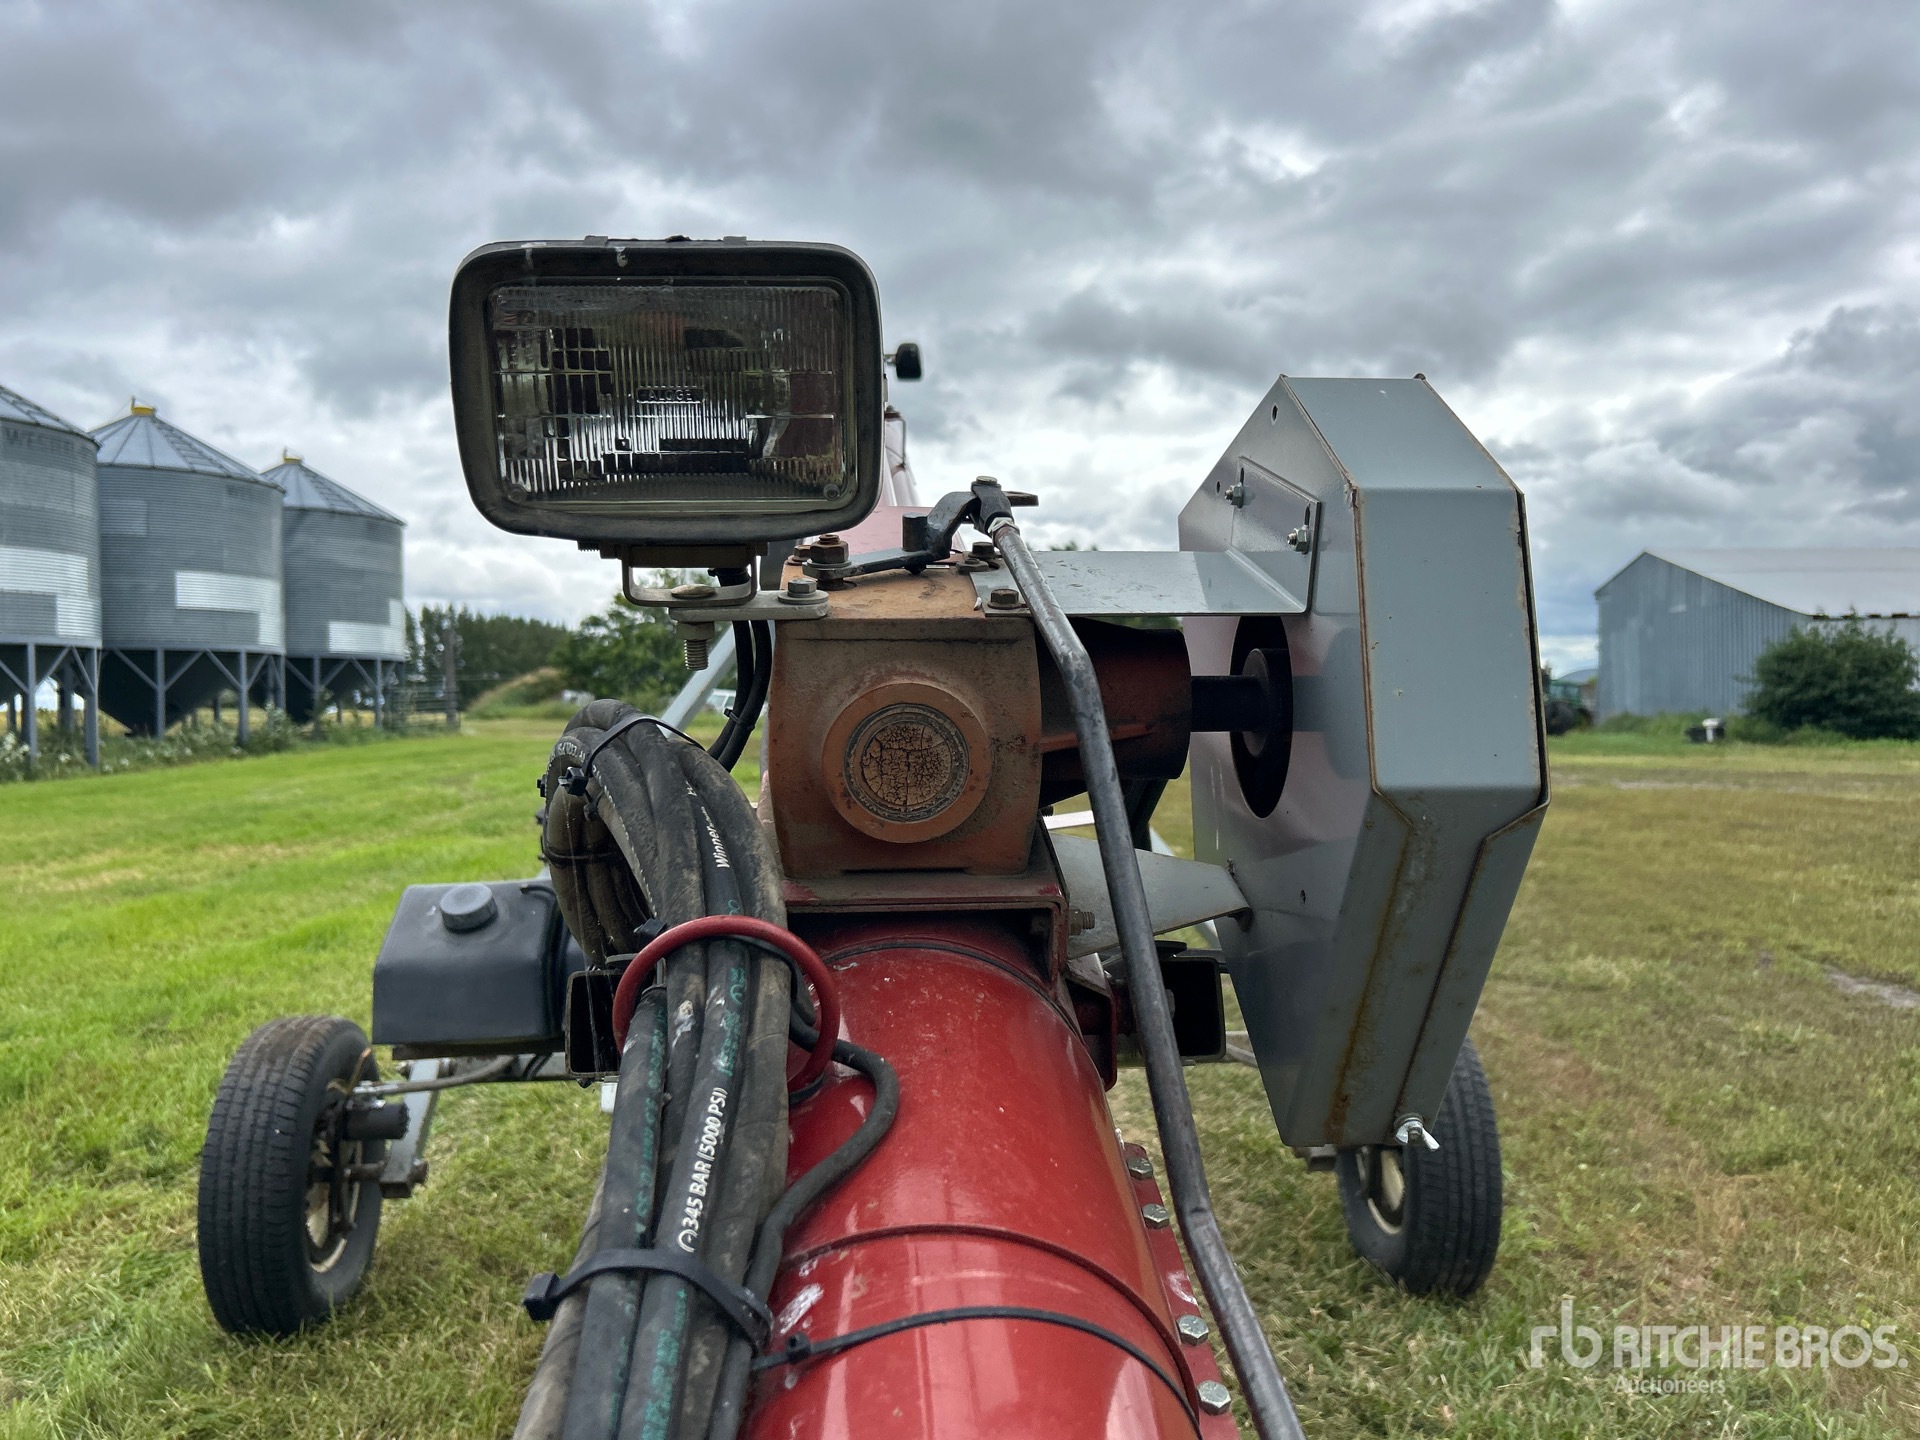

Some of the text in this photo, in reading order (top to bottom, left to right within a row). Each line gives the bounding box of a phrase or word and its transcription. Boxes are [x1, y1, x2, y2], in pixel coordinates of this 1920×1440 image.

[706, 826, 730, 868] Winner
[682, 1087, 729, 1230] 345 BAR (5000 PSI)
